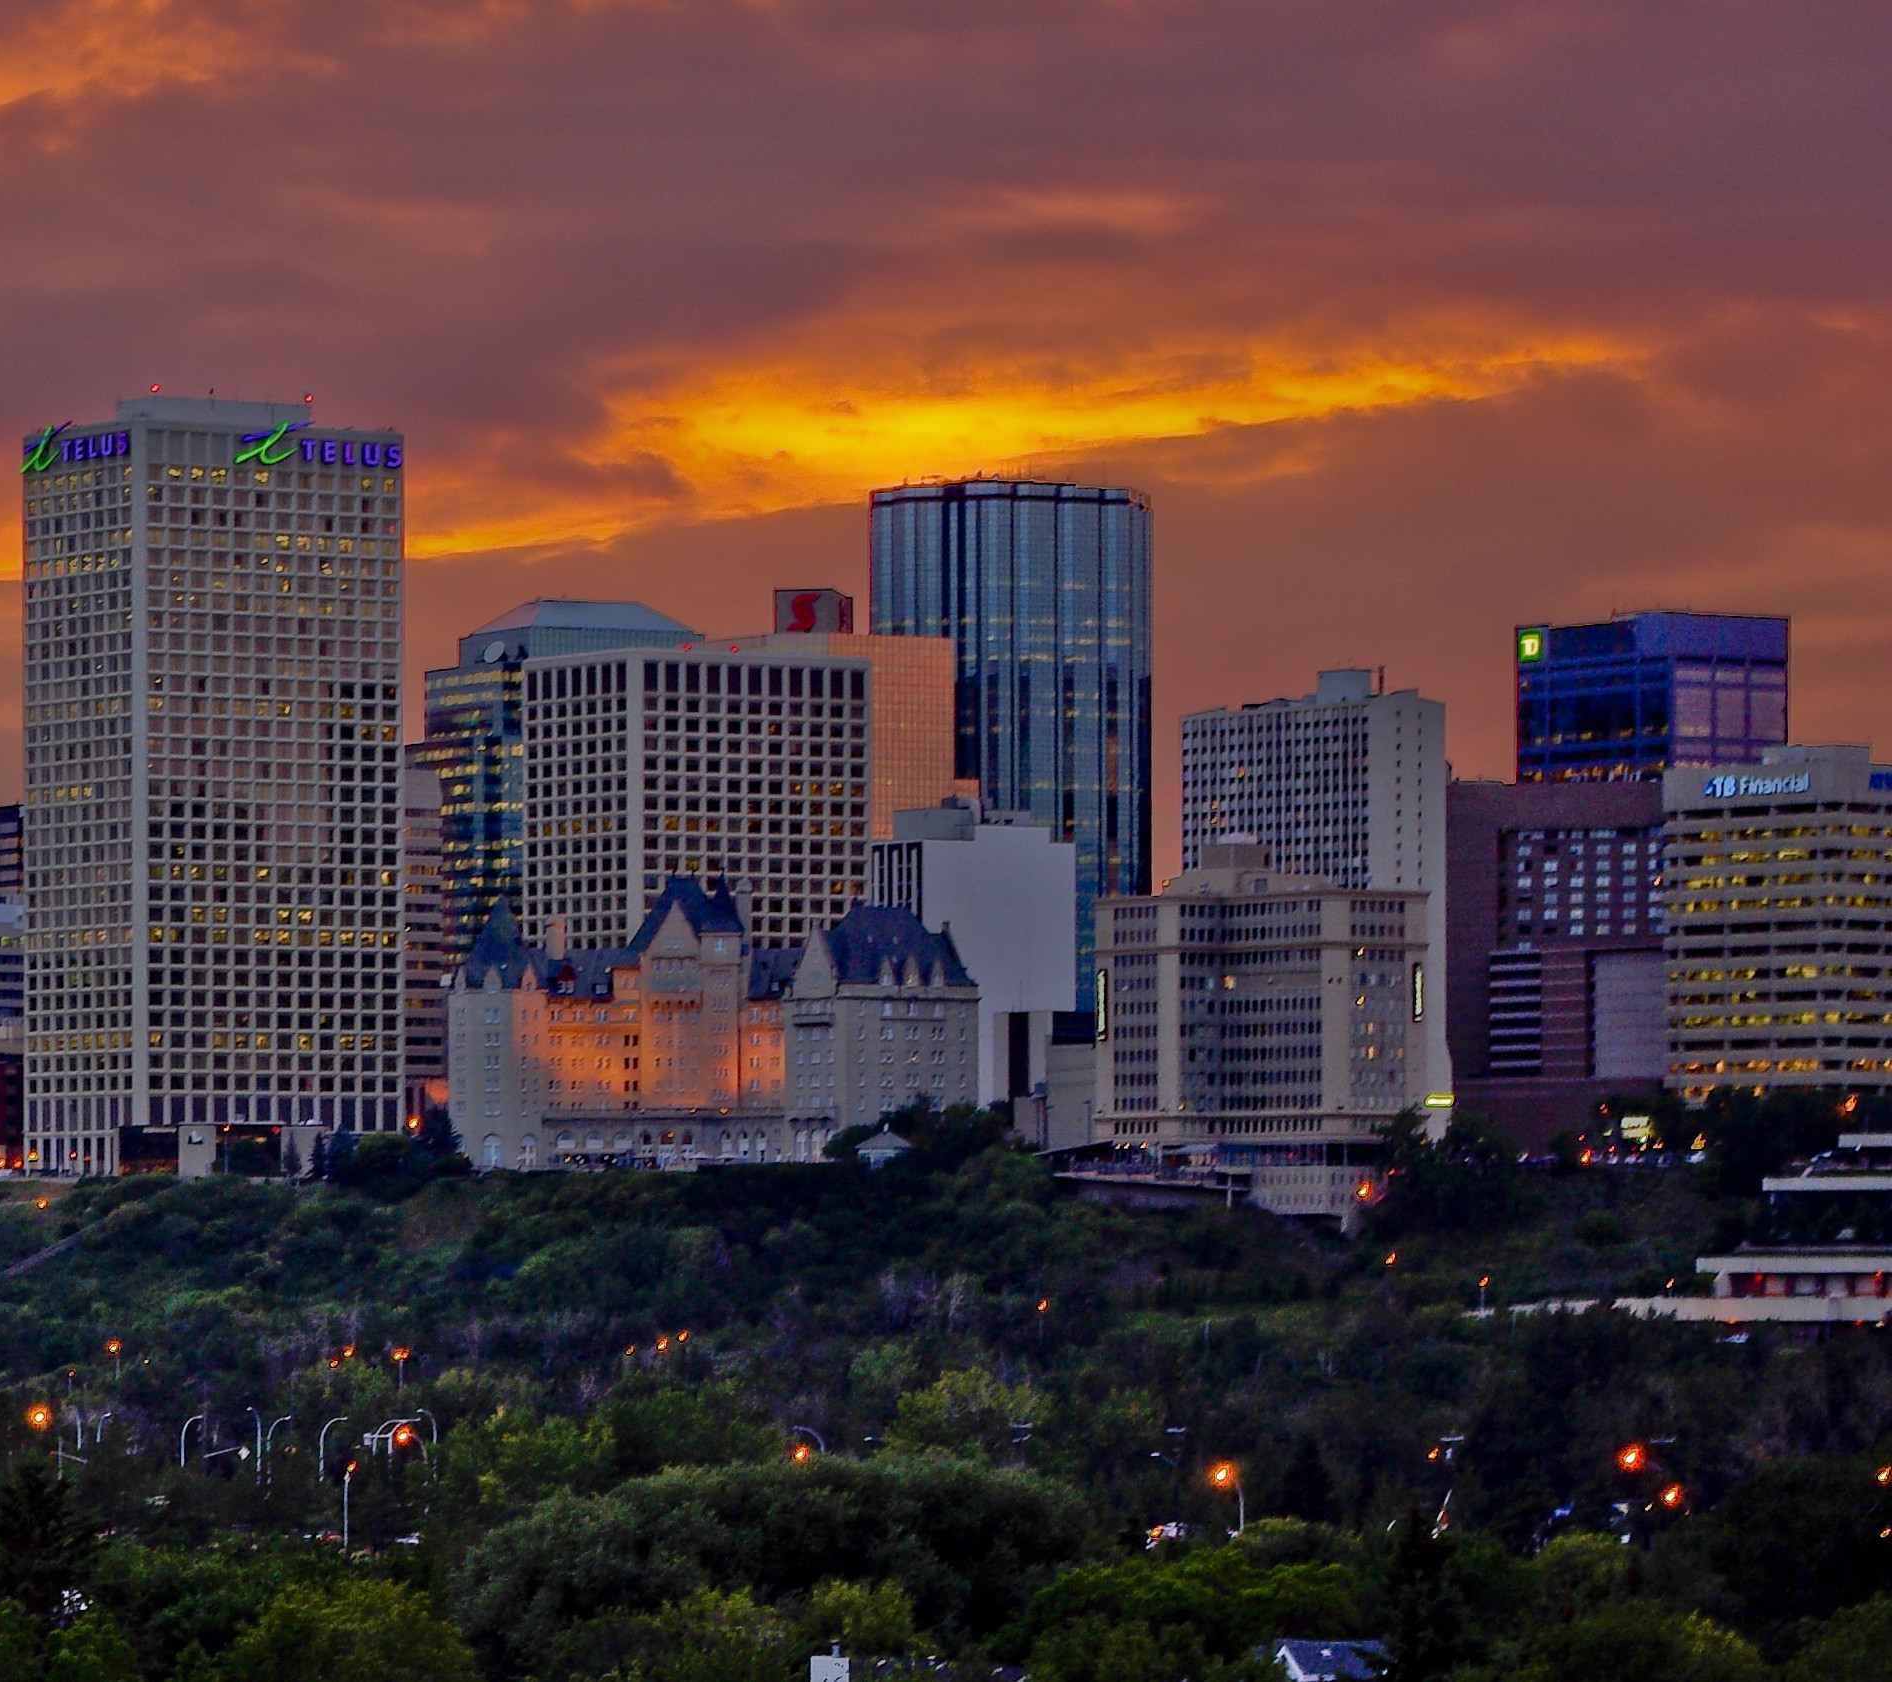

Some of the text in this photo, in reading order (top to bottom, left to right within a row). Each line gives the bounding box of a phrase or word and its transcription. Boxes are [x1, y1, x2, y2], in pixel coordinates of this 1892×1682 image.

[60, 431, 129, 462] TELUS
[300, 439, 403, 468] TELUS
[1520, 638, 1539, 656] TD
[1739, 771, 1810, 796] Financial
